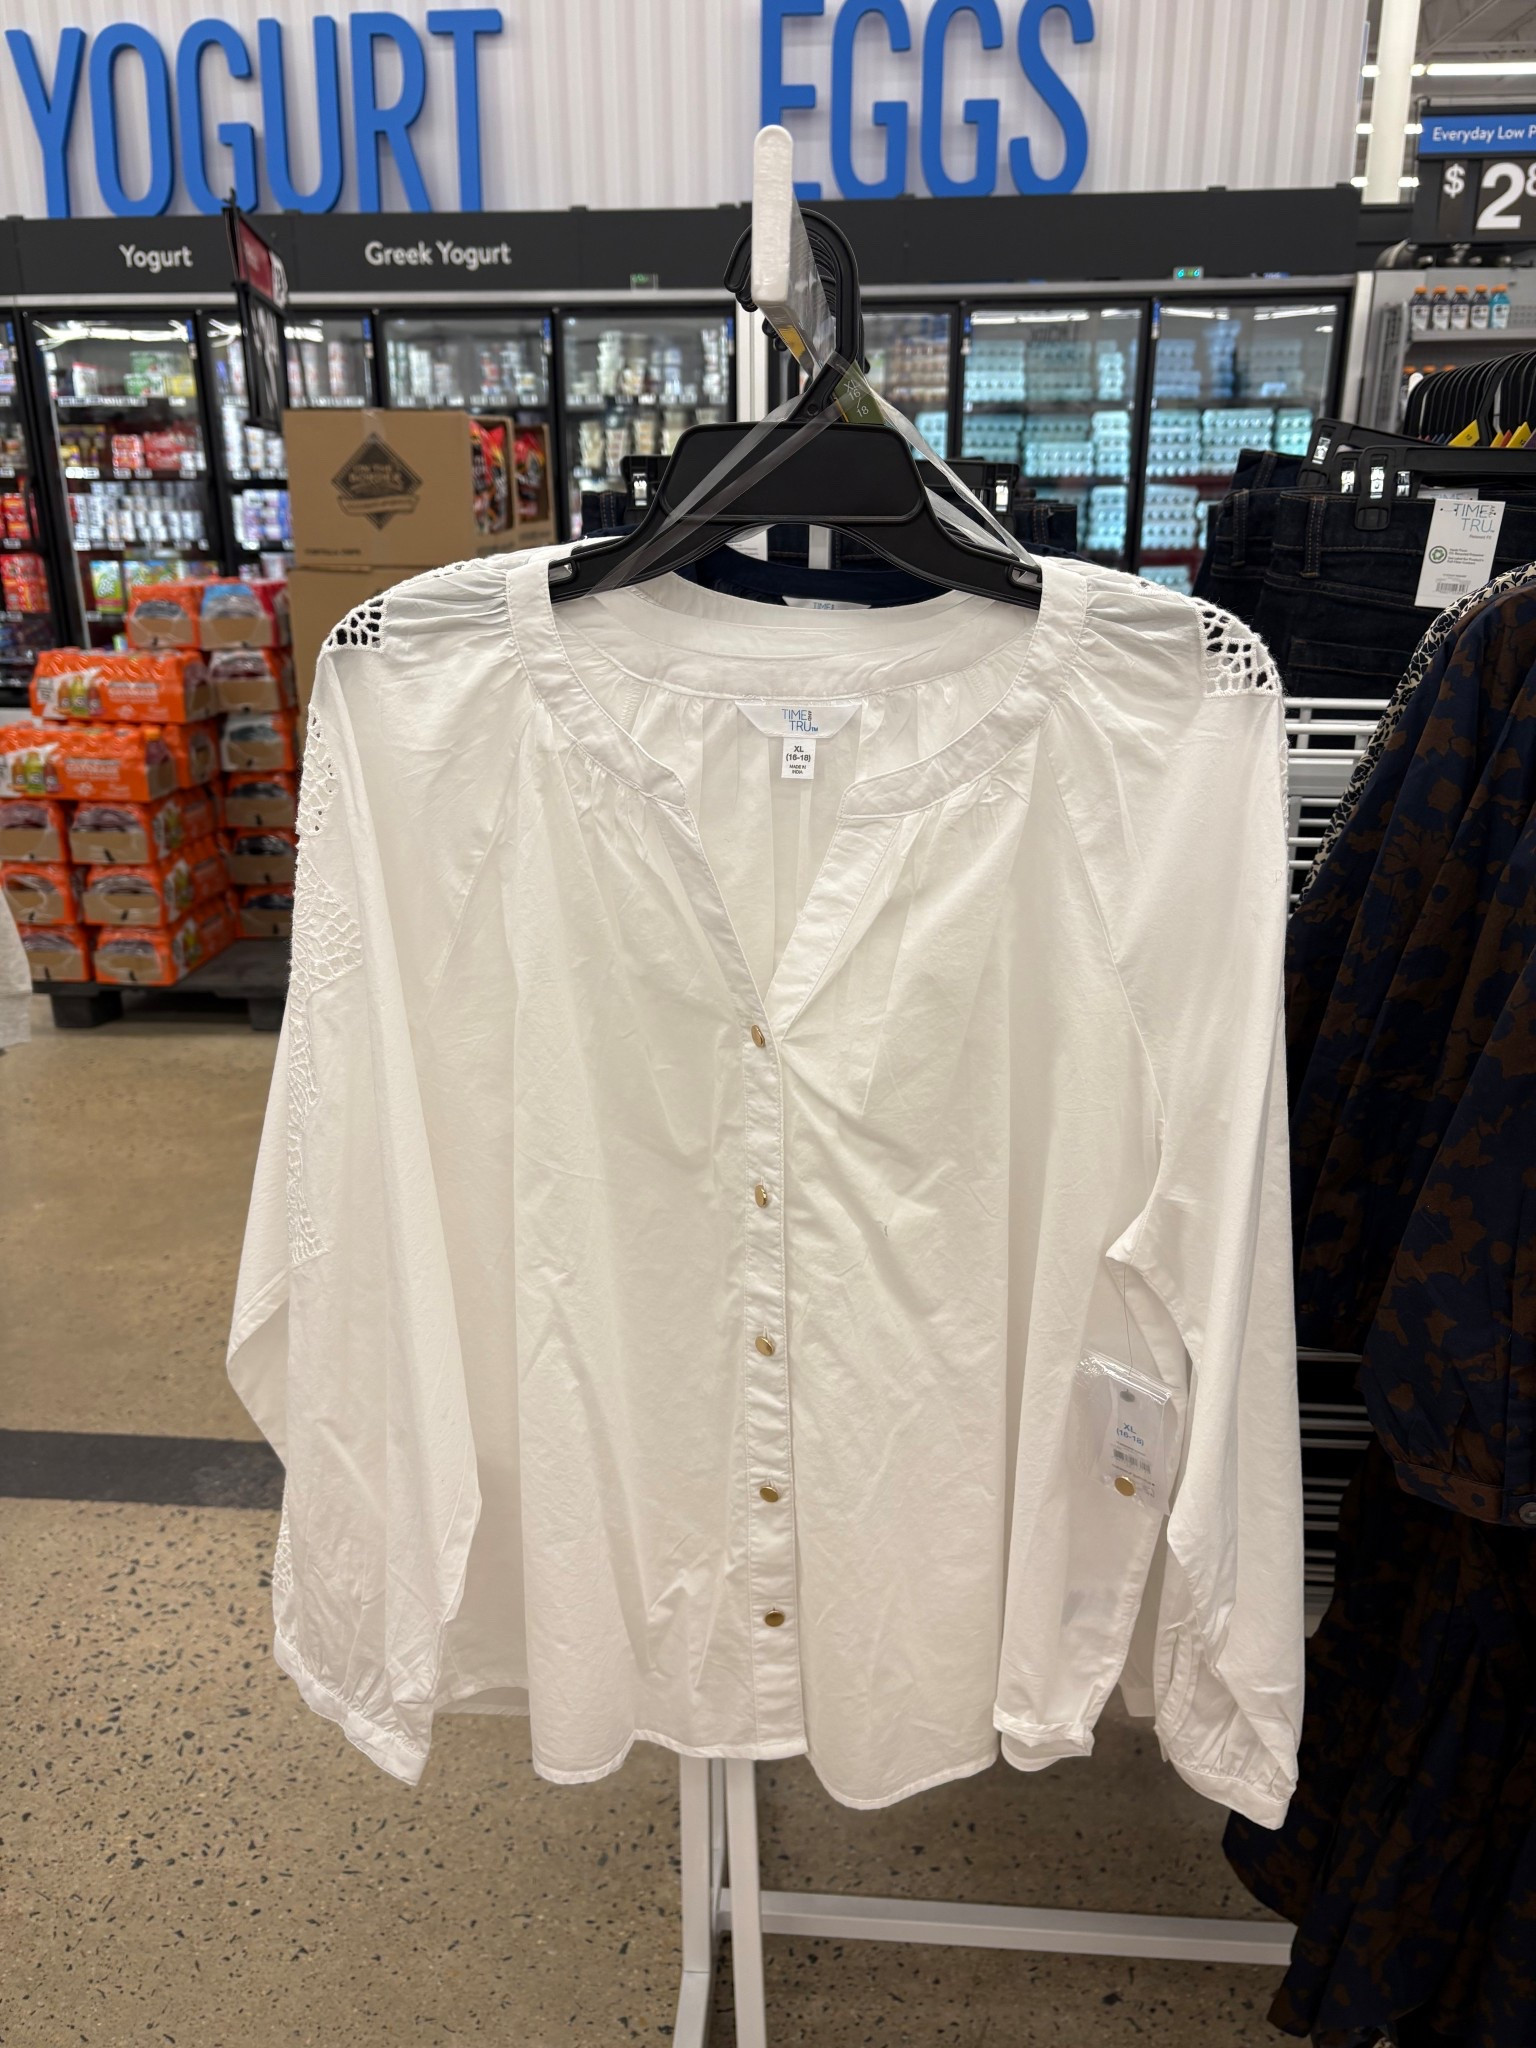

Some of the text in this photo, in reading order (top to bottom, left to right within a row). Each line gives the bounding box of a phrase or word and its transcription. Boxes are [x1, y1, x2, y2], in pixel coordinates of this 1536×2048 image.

[761, 0, 1095, 200] EGGS
[5, 8, 503, 219] YOGURT
[1432, 126, 1495, 144] Everyday
[1497, 125, 1525, 139] Low
[119, 244, 193, 273] Yogurt
[365, 241, 512, 273] Greek Yogurt
[1453, 503, 1489, 518] TIME
[1461, 518, 1492, 532] TRU
[781, 709, 807, 721] TIME
[786, 753, 811, 762] (16-18)
[1116, 1428, 1144, 1446] (16-18)
[1123, 1423, 1137, 1434] XL
